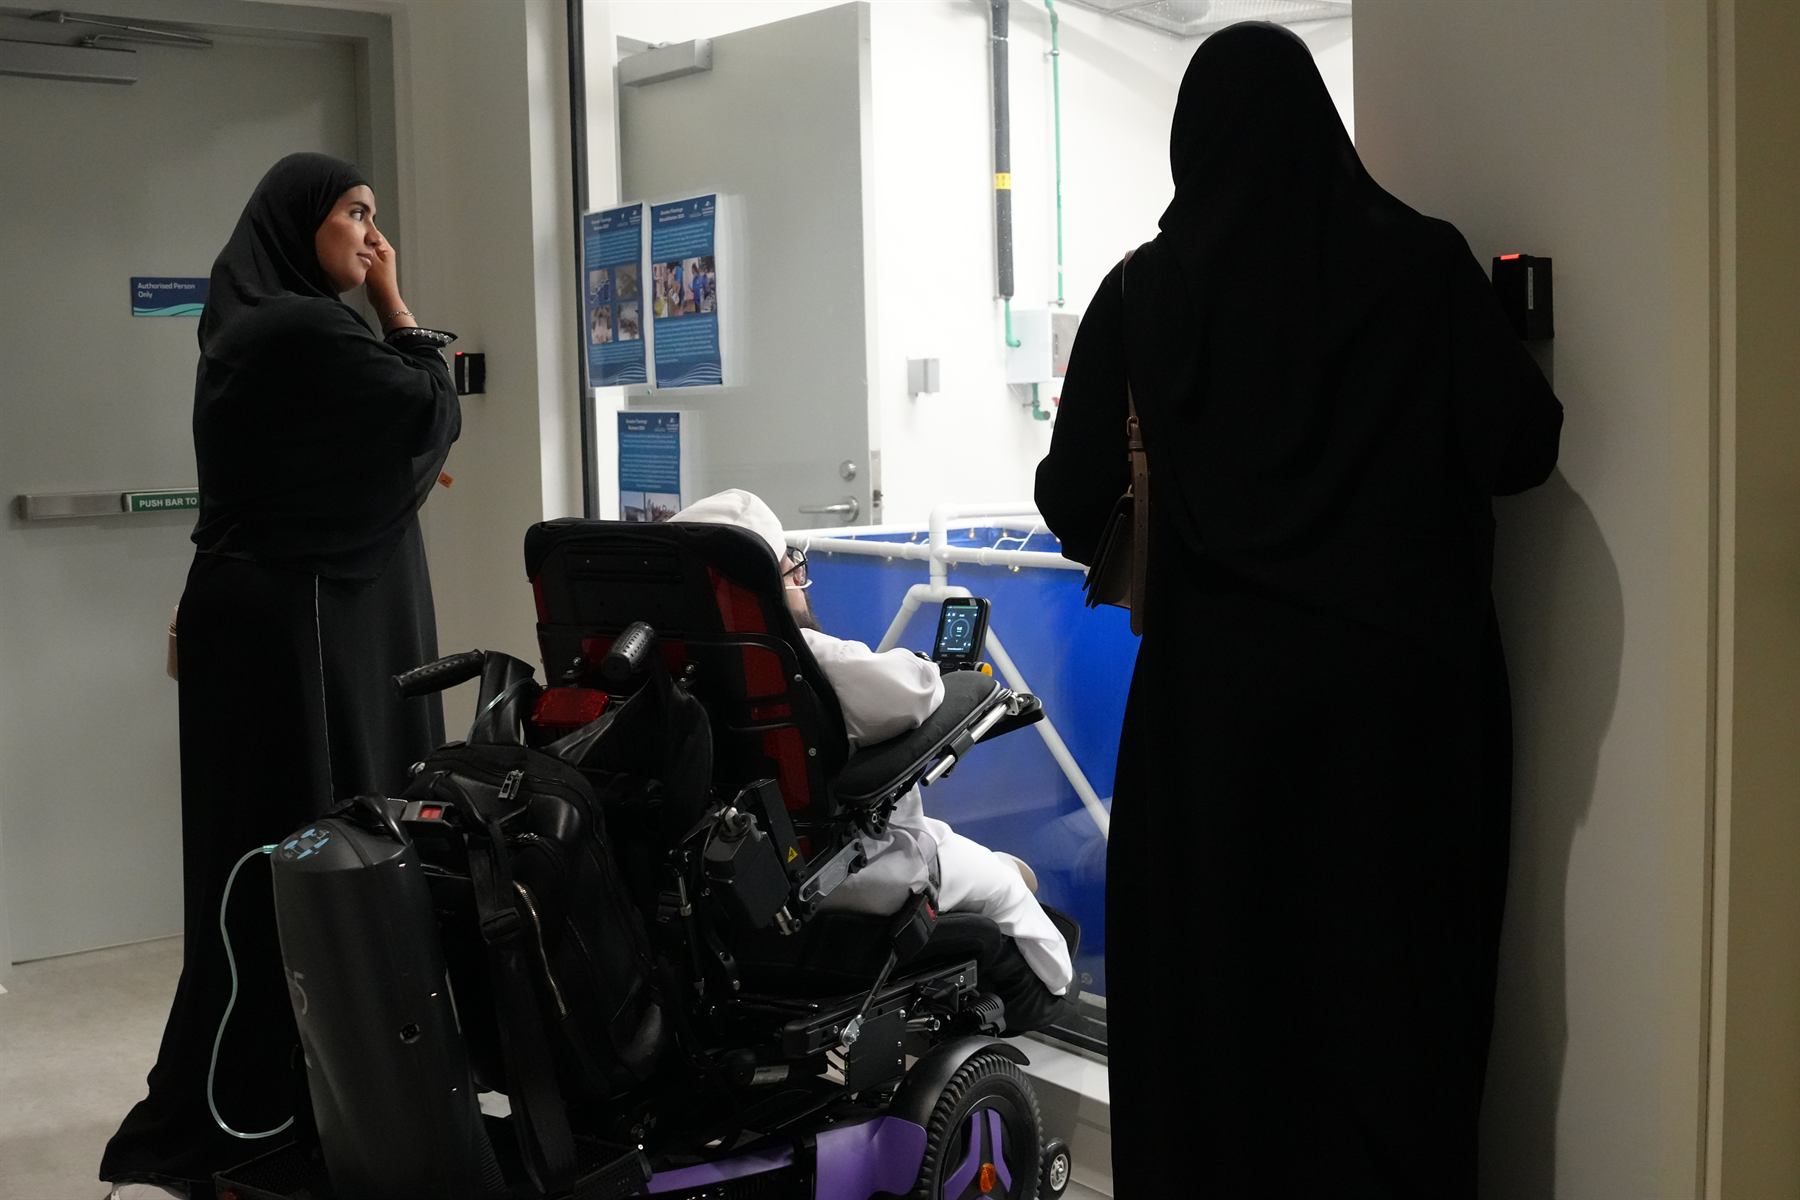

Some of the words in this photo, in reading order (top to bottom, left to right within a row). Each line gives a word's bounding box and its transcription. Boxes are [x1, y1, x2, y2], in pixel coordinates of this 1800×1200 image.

[138, 291, 152, 299] Only
[139, 499, 163, 508] PUSH
[165, 498, 184, 507] BAR
[185, 497, 197, 505] TO
